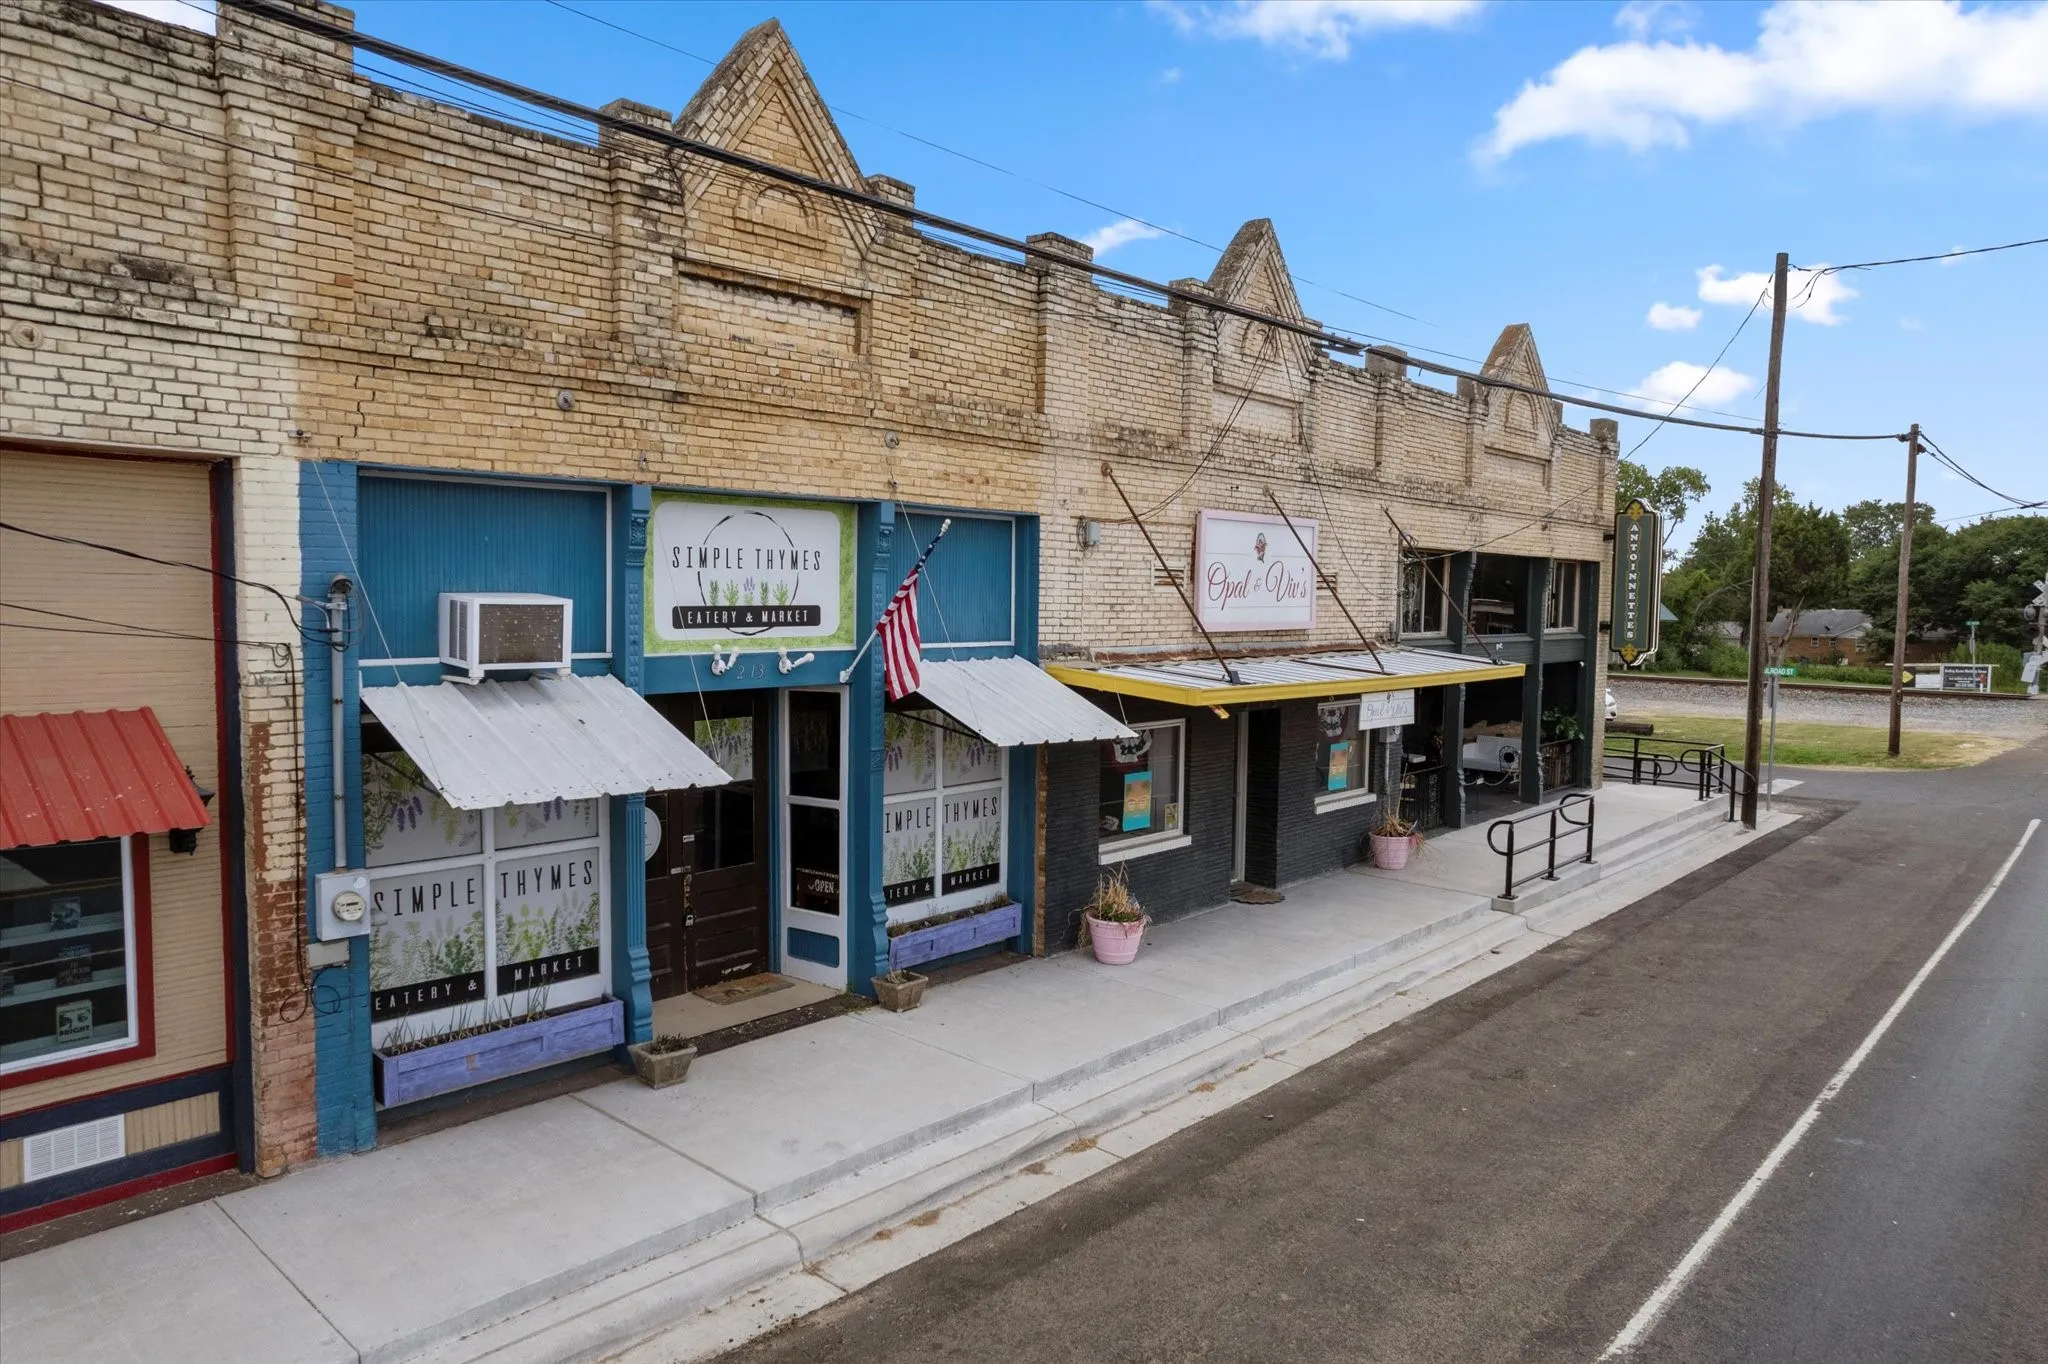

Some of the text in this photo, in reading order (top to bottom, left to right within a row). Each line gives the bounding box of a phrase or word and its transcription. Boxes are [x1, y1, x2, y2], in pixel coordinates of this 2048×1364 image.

[672, 546, 821, 571] SIMPLE THYMES
[1207, 561, 1252, 611] Opal
[1265, 560, 1307, 602] Viv's
[1626, 523, 1640, 639] ANTOINNETTES
[687, 609, 808, 625] EATERY & MARKET
[737, 663, 765, 679] 213
[885, 796, 998, 833] IMPLE THYMES
[374, 860, 593, 917] SIMPLE THYMES
[814, 879, 834, 894] OPEN
[889, 868, 991, 900] TERY & MARKET
[375, 955, 584, 1011] EATERY & MARKET
